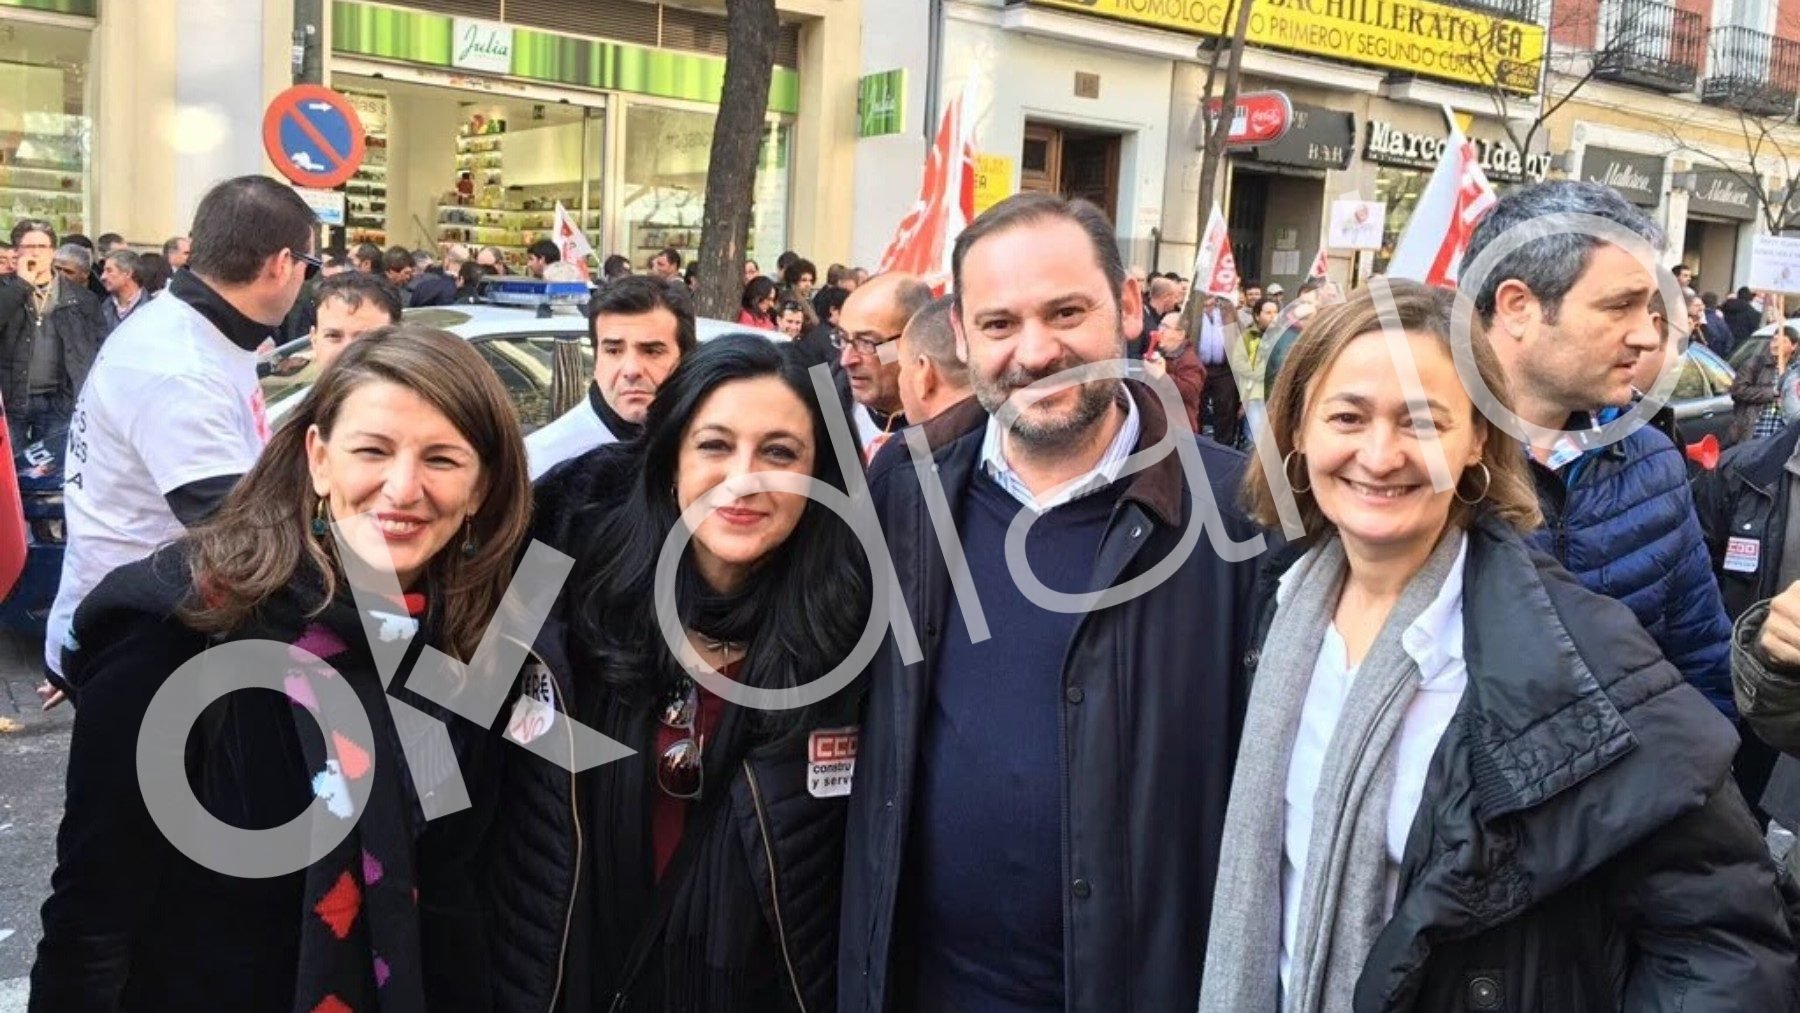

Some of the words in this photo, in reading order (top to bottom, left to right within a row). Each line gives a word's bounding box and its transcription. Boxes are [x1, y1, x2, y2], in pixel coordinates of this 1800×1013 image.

[459, 24, 508, 61] Julia
[1270, 15, 1341, 49] PRIMERO
[1344, 32, 1354, 52] Y
[1358, 33, 1434, 67] SEGUNDO
[811, 778, 820, 790] y
